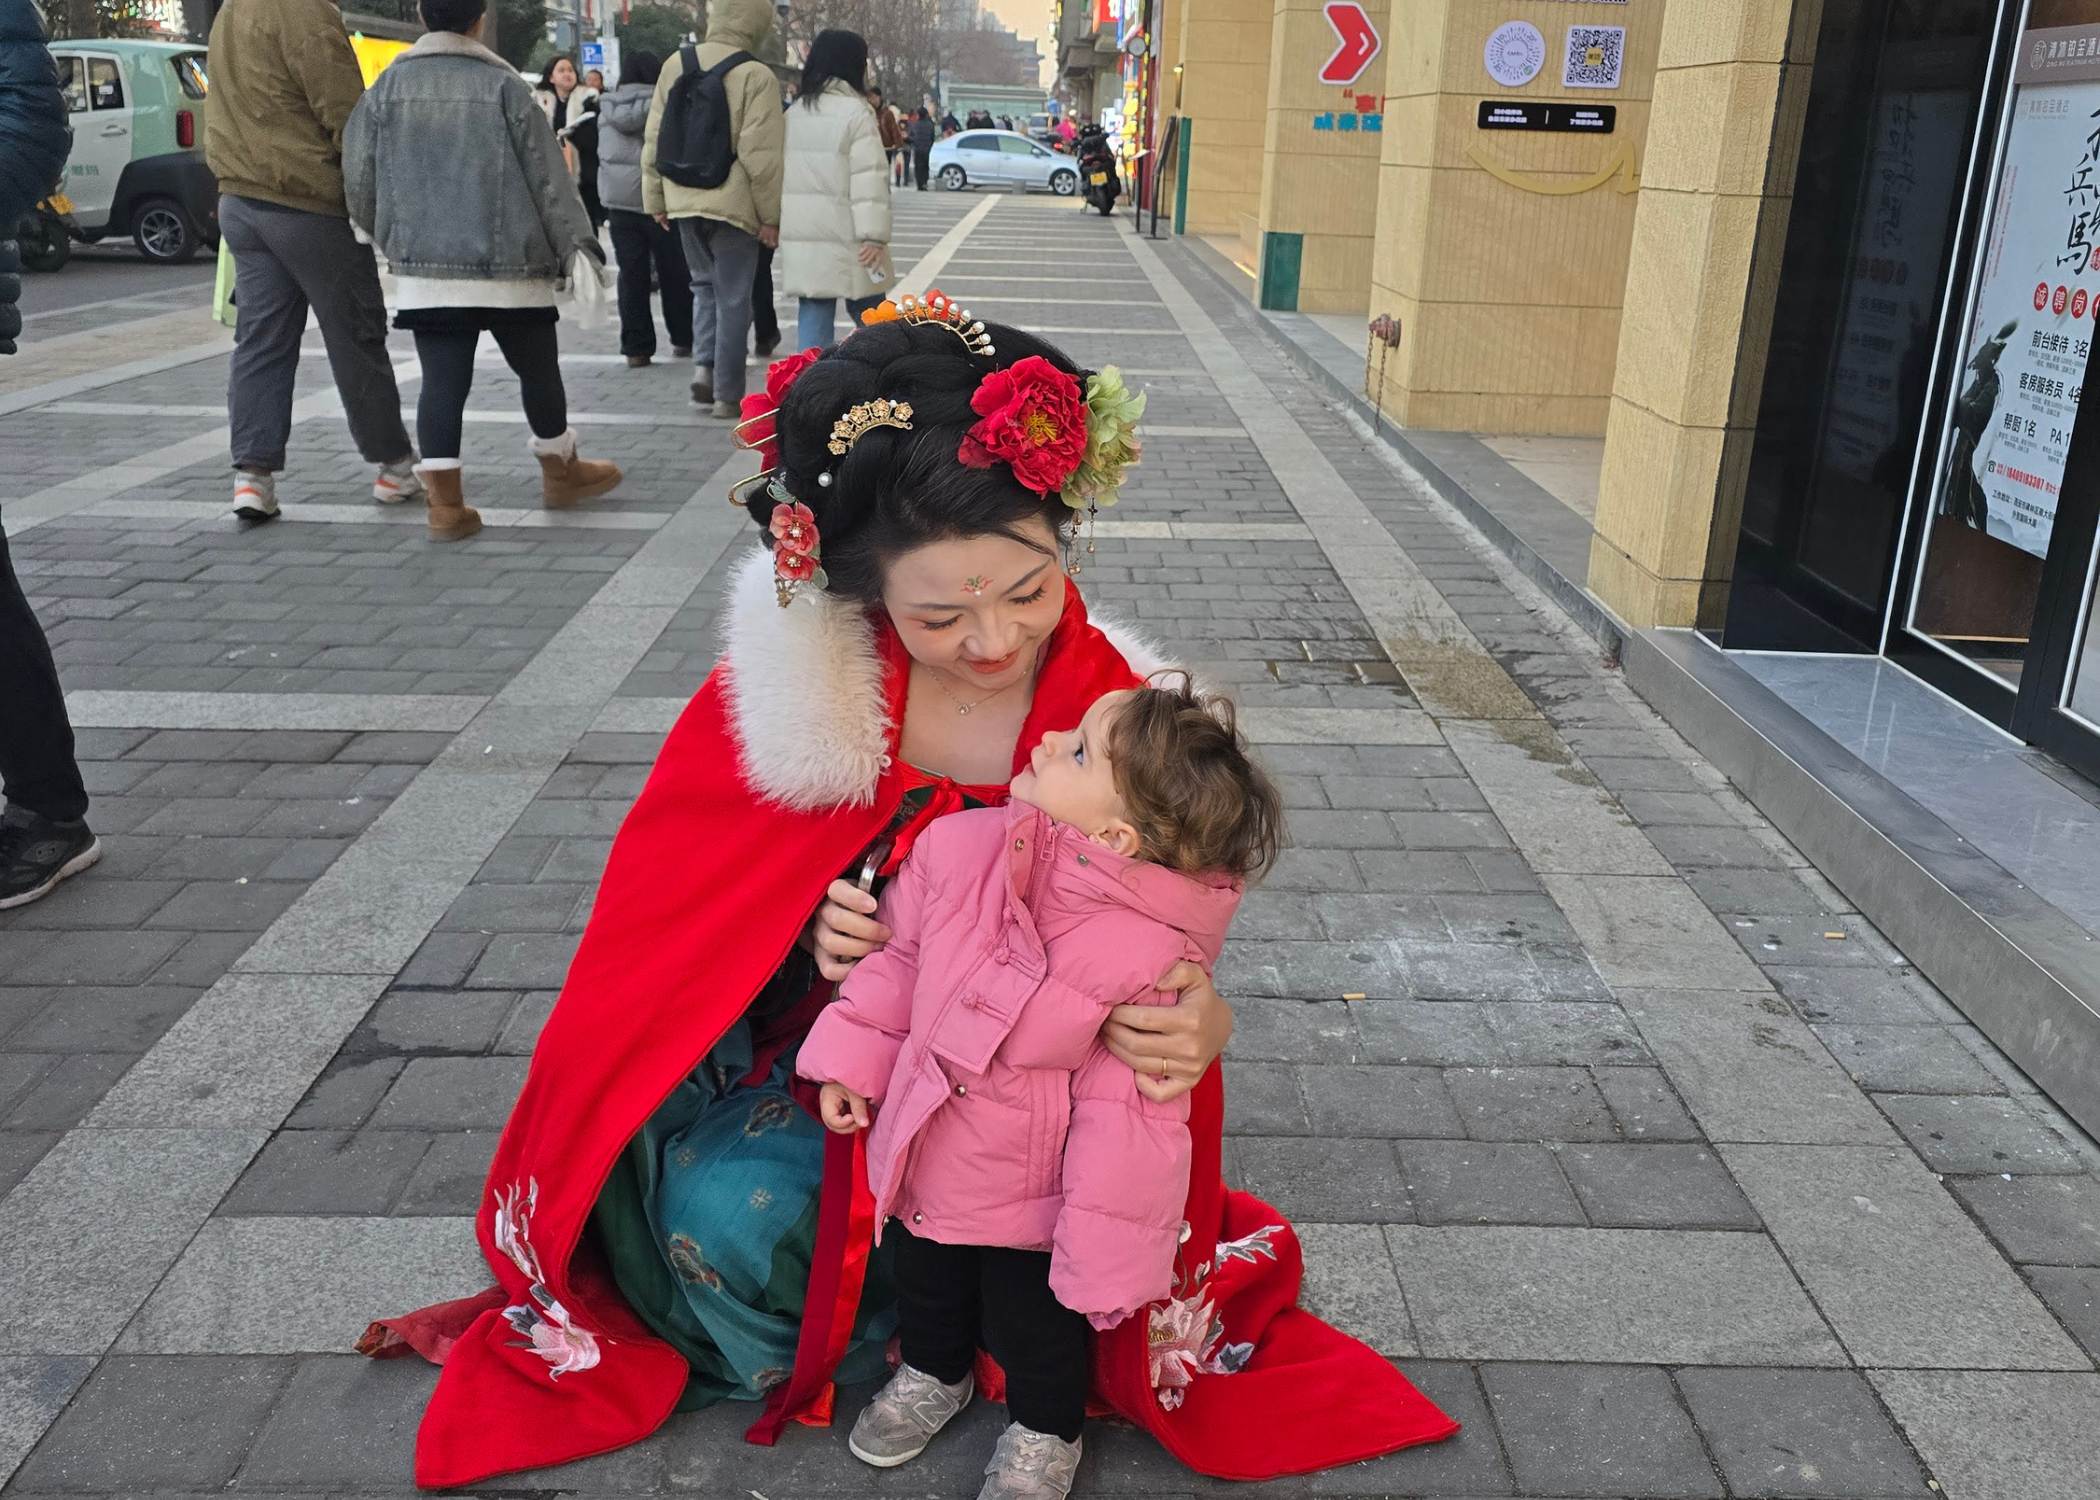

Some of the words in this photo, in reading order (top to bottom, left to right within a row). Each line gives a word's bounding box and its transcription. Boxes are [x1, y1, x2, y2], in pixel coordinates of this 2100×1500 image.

[2032, 329, 2069, 354] 前台接待
[2073, 340, 2089, 358] 3名
[2020, 372, 2064, 399] 客房服务员
[2050, 428, 2062, 446] PA
